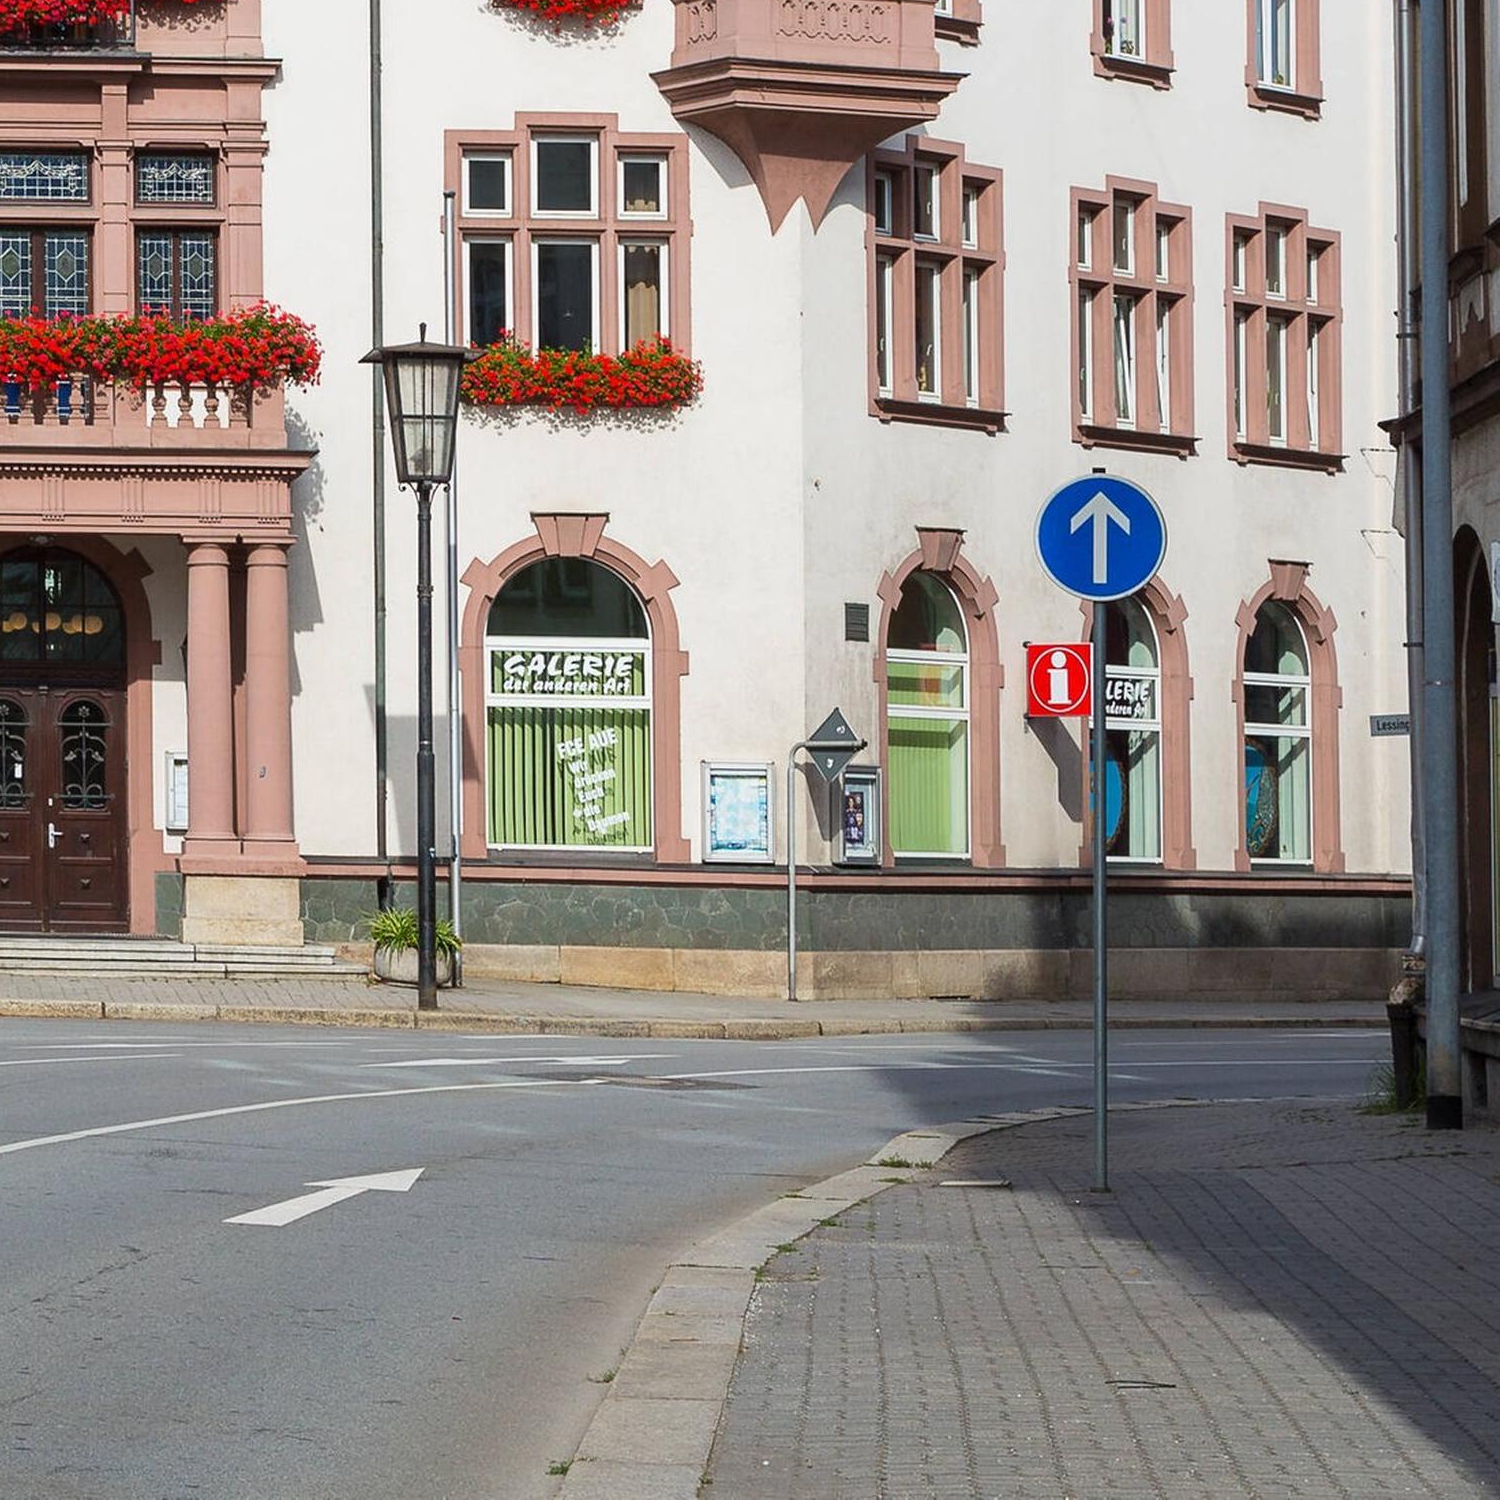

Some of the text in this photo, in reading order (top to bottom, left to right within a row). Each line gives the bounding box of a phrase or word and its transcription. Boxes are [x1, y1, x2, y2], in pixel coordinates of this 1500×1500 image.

[503, 653, 633, 677] GALERIE
[503, 676, 630, 694] der anderen Art
[1106, 680, 1150, 700] LERIE
[589, 727, 618, 750] AUE
